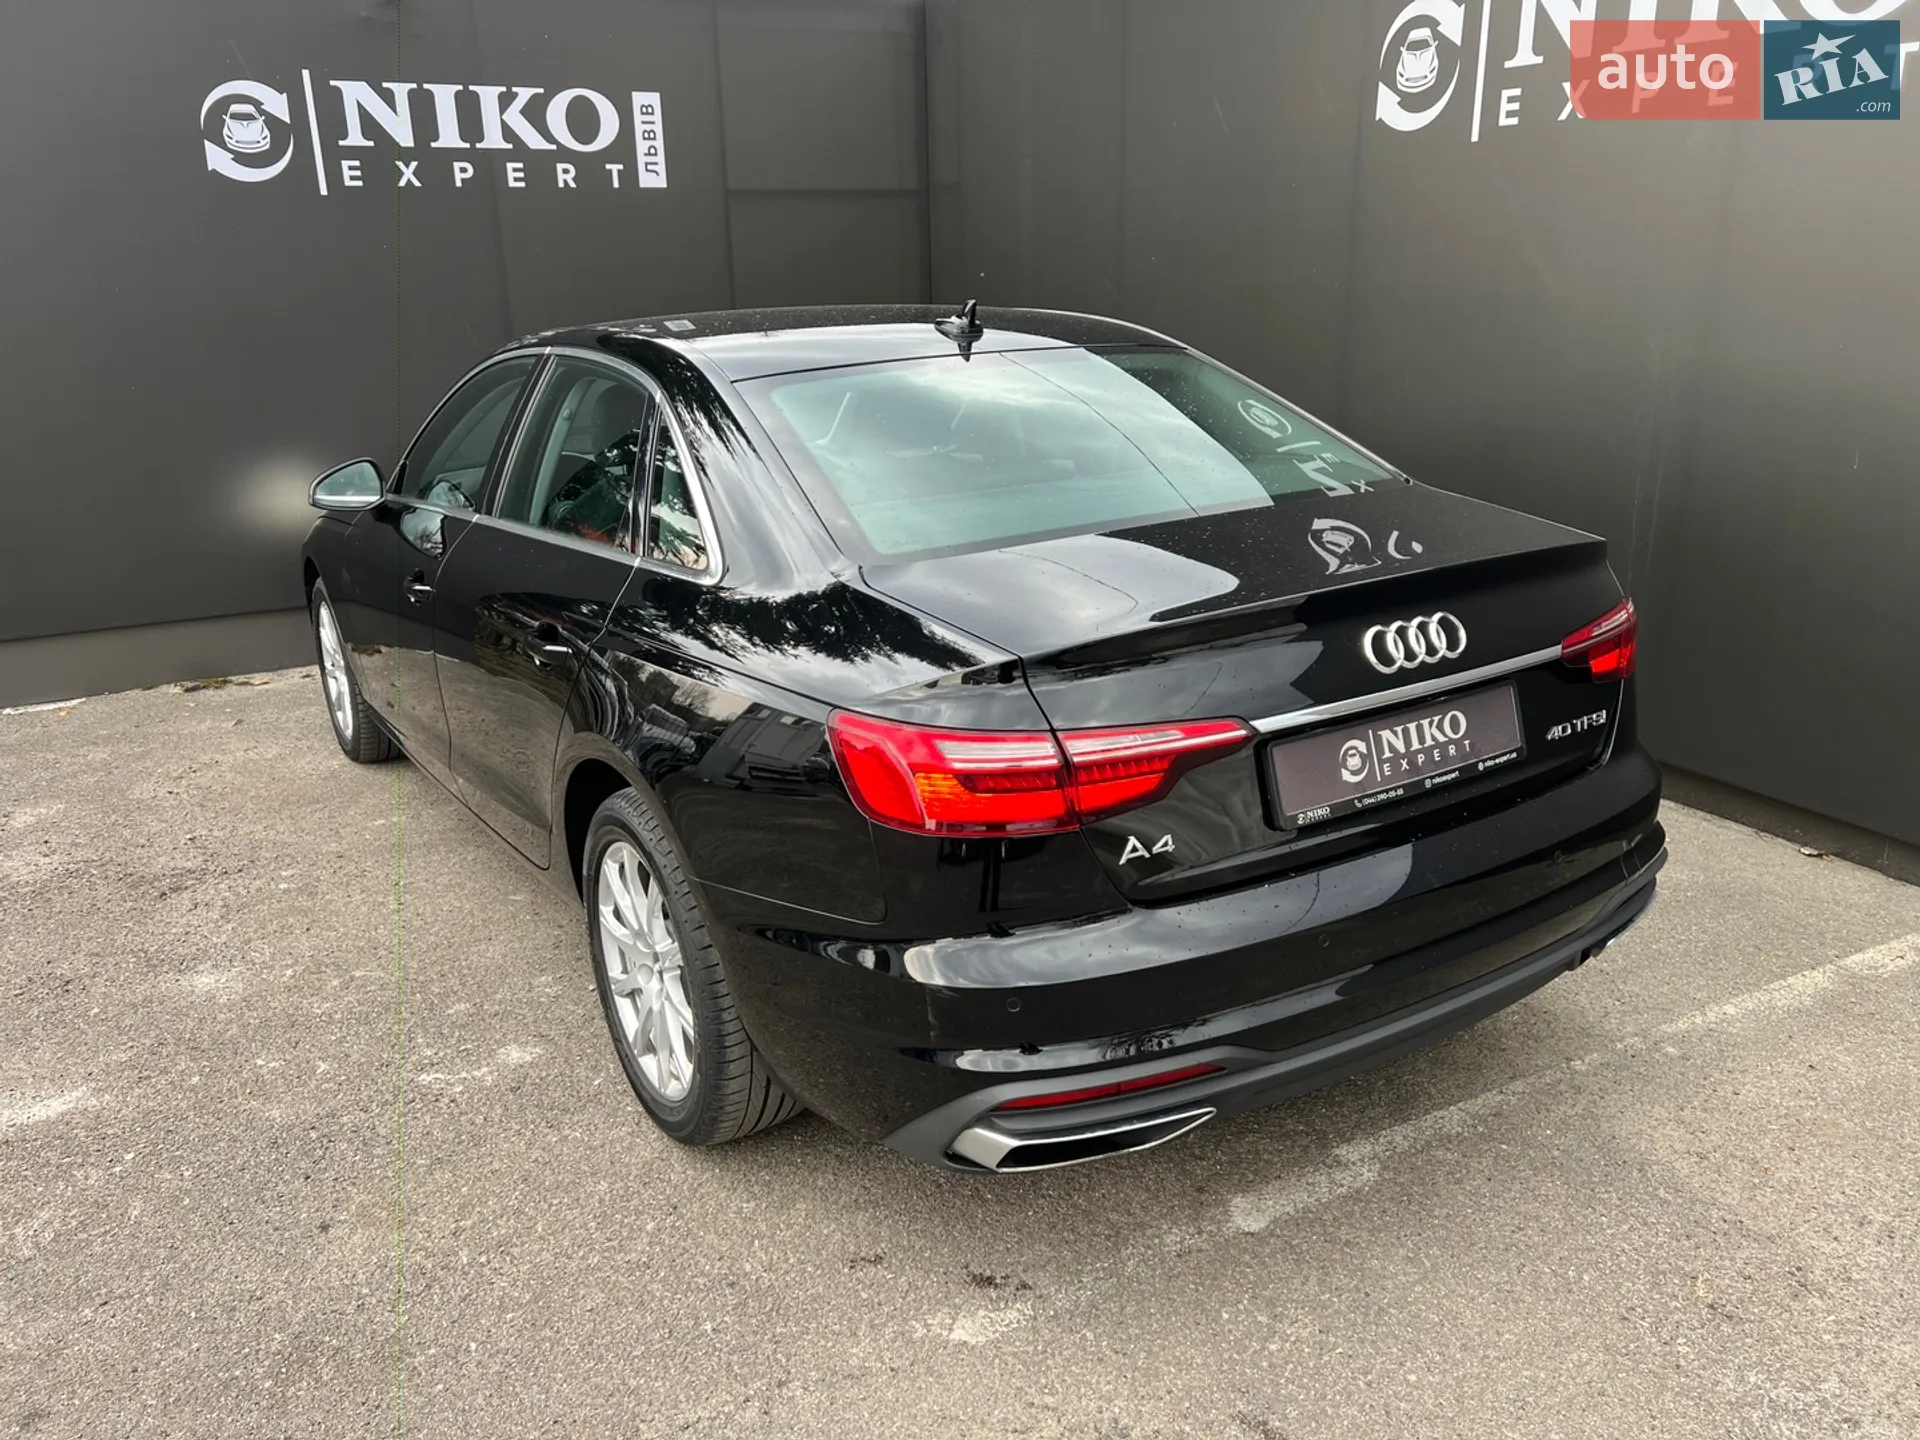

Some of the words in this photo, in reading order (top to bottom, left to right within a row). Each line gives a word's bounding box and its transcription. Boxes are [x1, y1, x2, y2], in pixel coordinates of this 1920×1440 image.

[329, 79, 620, 152] NIKO
[639, 103, 660, 177] ЛЬВІВ
[341, 159, 625, 188] EXPERT
[1377, 710, 1467, 759] NIKO
[1546, 721, 1572, 741] 40
[1572, 709, 1607, 732] TFSI
[1383, 740, 1471, 776] EXPERT
[1306, 806, 1331, 819] NIKO
[1118, 834, 1175, 865] A4
